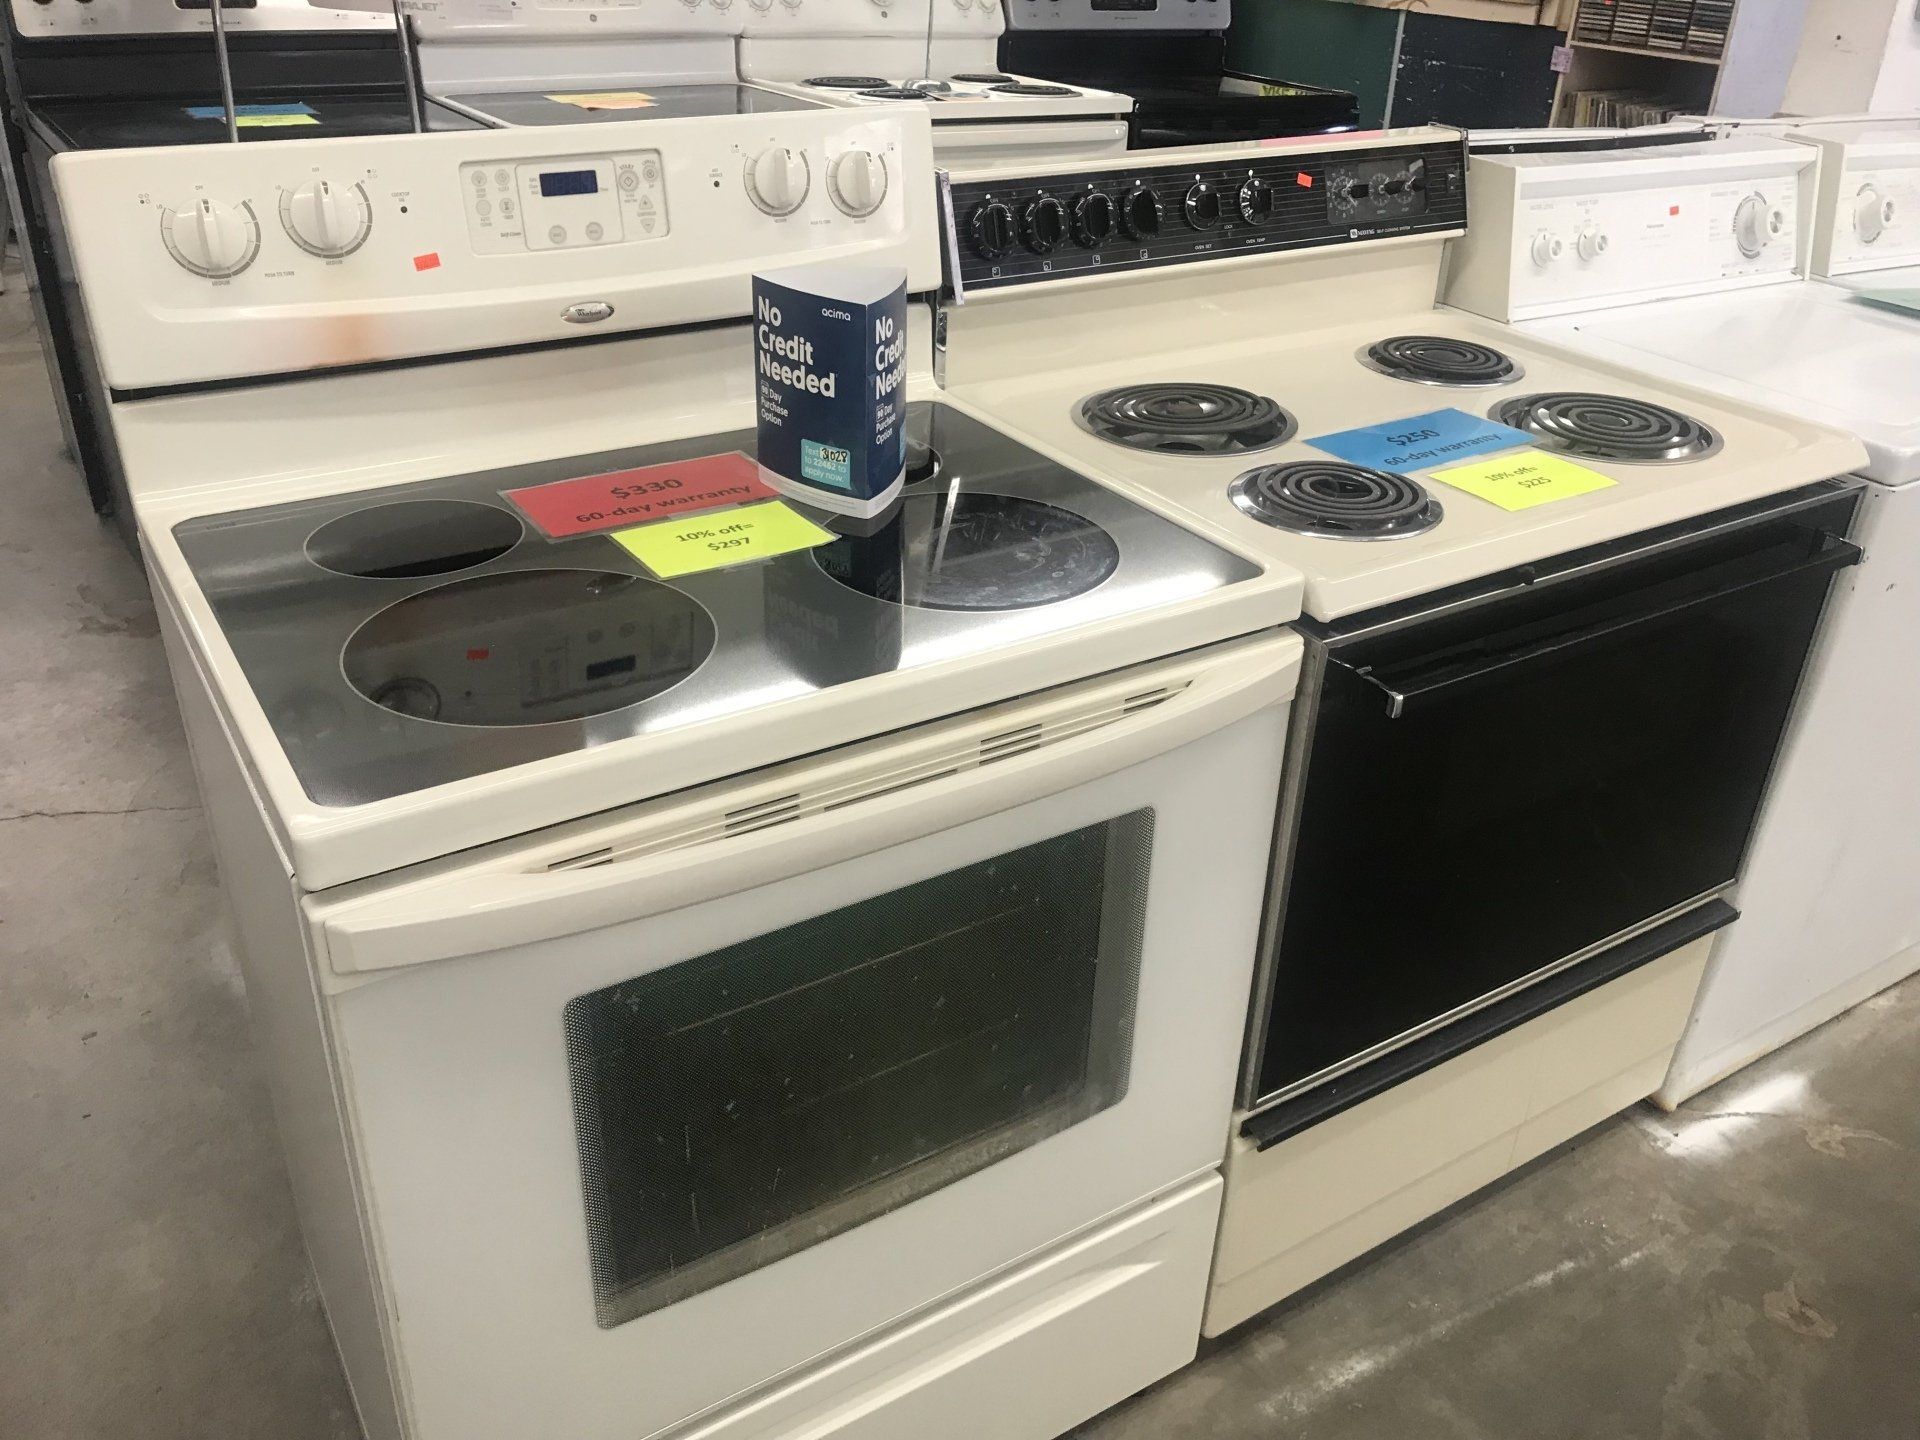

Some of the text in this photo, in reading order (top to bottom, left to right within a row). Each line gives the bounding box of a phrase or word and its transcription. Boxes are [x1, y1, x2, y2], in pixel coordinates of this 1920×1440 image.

[758, 295, 782, 327] No
[821, 307, 851, 321] acima
[876, 316, 893, 345] No
[758, 324, 814, 365] Credit
[876, 329, 904, 371] Credit
[759, 350, 835, 398] Needed
[770, 388, 782, 404] Day
[761, 396, 788, 417] Purchase
[884, 403, 893, 415] Day
[761, 408, 782, 427] Option
[876, 412, 896, 433] Purchase
[876, 428, 893, 445] Option
[1386, 429, 1440, 447] $250
[1384, 433, 1502, 466] 60-day warranty
[838, 465, 847, 473] to
[1484, 472, 1515, 481] 10%
[611, 479, 682, 499] $330
[1518, 477, 1552, 488] $225
[576, 486, 751, 522] 60-day warranty
[675, 523, 755, 542] 10% off=
[707, 537, 750, 551] $297
